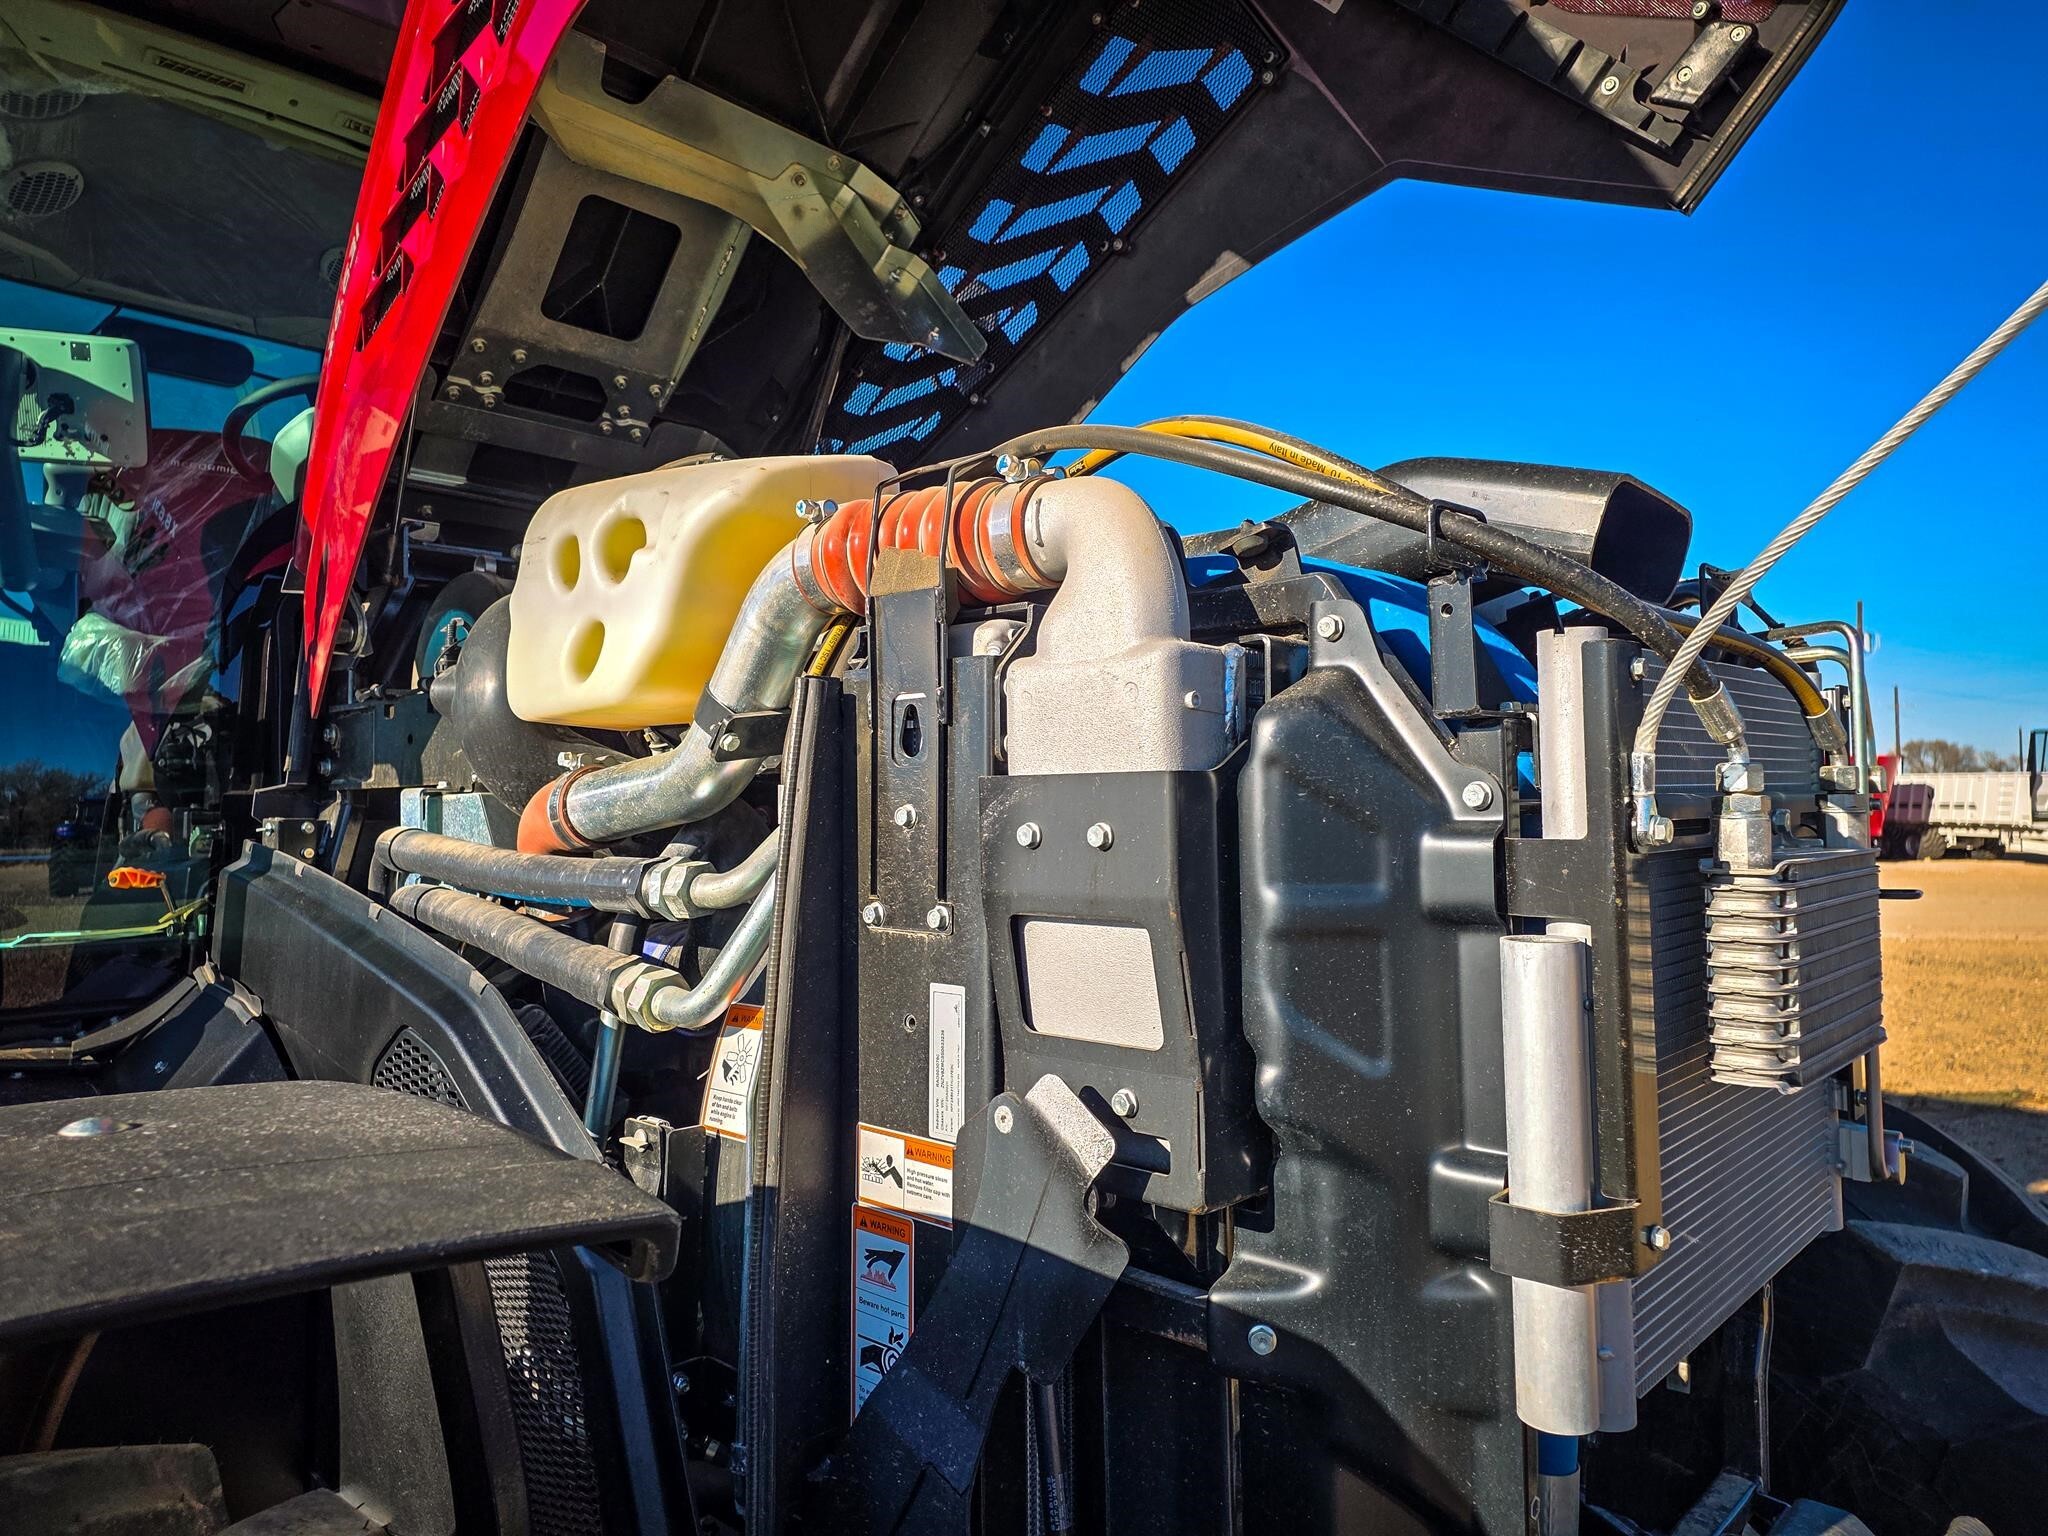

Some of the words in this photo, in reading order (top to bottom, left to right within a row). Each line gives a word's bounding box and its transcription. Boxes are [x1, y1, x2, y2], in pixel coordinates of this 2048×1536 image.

[1268, 441, 1287, 458] Italy
[1289, 450, 1300, 461] in
[1300, 455, 1326, 473] Made
[914, 1147, 951, 1165] WARNING
[906, 1168, 916, 1176] High
[916, 1171, 935, 1180] pressure
[906, 1181, 923, 1190] Remove
[906, 1189, 923, 1198] extreme
[869, 1219, 906, 1239] WARNING
[858, 1295, 880, 1310] Beware
[880, 1303, 890, 1314] hot
[890, 1309, 906, 1320] parts
